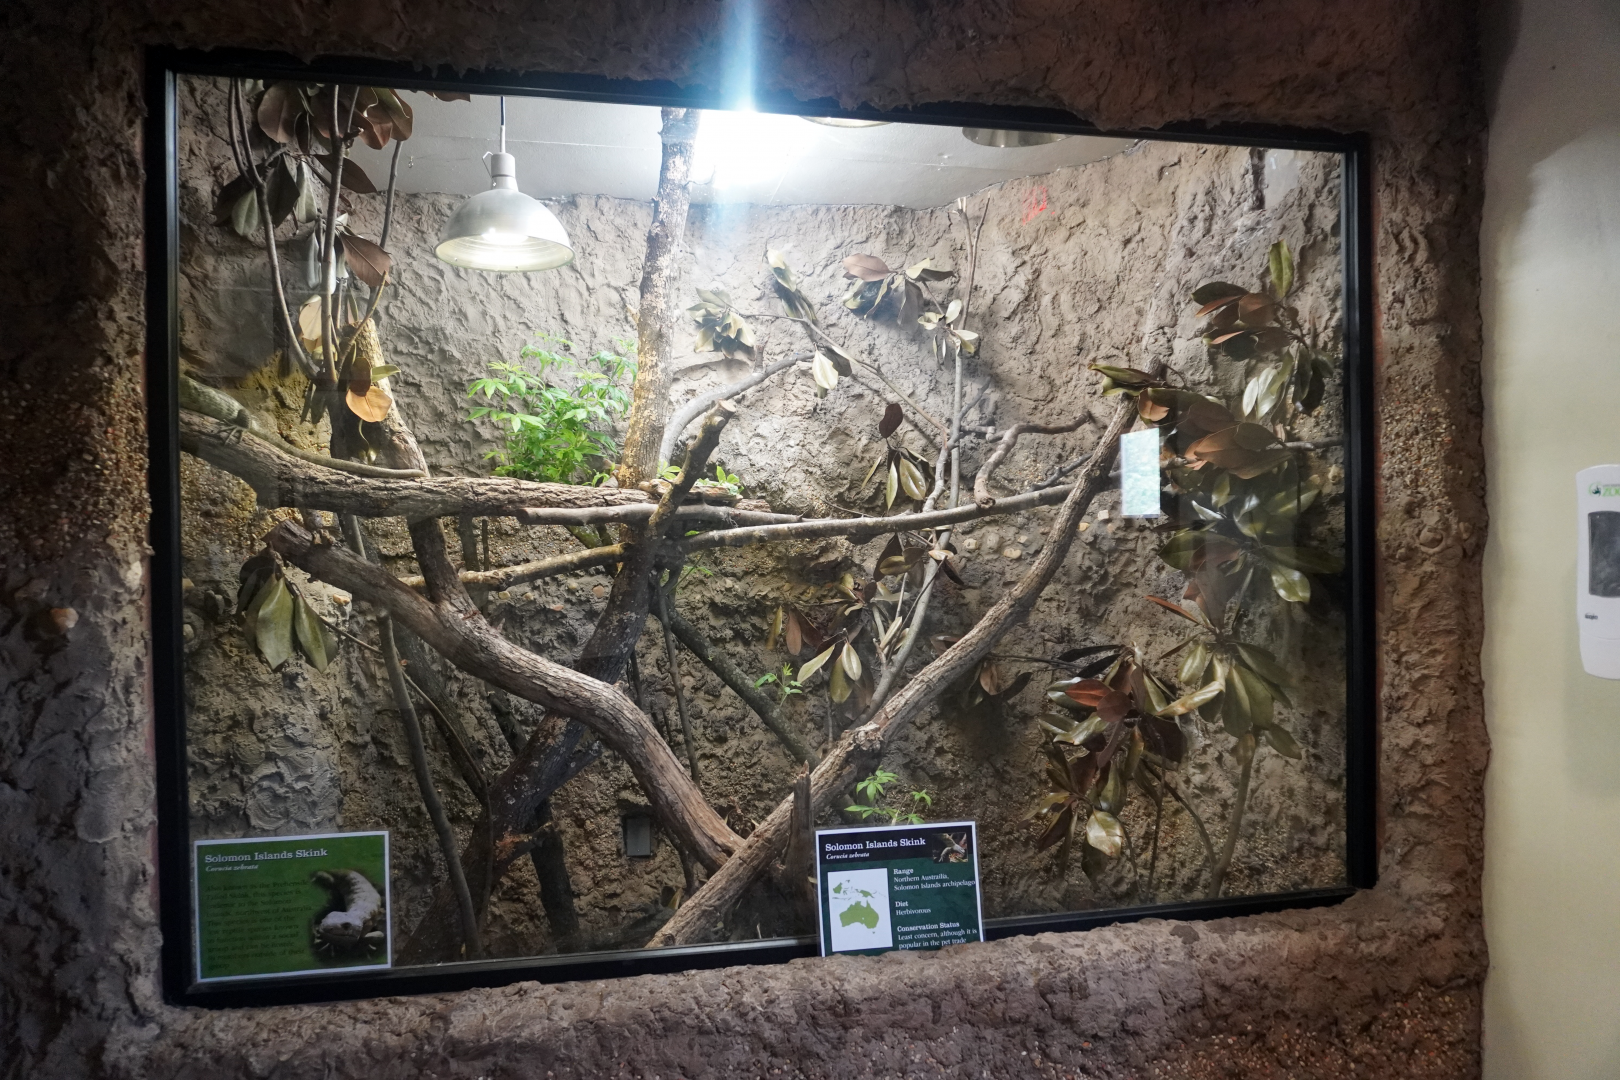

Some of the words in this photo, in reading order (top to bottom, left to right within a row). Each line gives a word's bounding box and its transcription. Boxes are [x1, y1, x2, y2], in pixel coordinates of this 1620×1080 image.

[825, 843, 863, 852] Solomon
[866, 840, 898, 849] Islands
[900, 837, 926, 847] Skink
[205, 854, 251, 863] Solomon
[254, 851, 293, 860] Islands
[296, 848, 328, 858] Skink
[894, 883, 920, 891] Solomon
[942, 879, 976, 888] archipelago
[896, 908, 931, 916] Herbivorous
[897, 923, 938, 932] Conservation
[940, 921, 960, 929] Status
[940, 929, 965, 937] although
[899, 942, 921, 950] popular
[941, 939, 951, 947] pet
